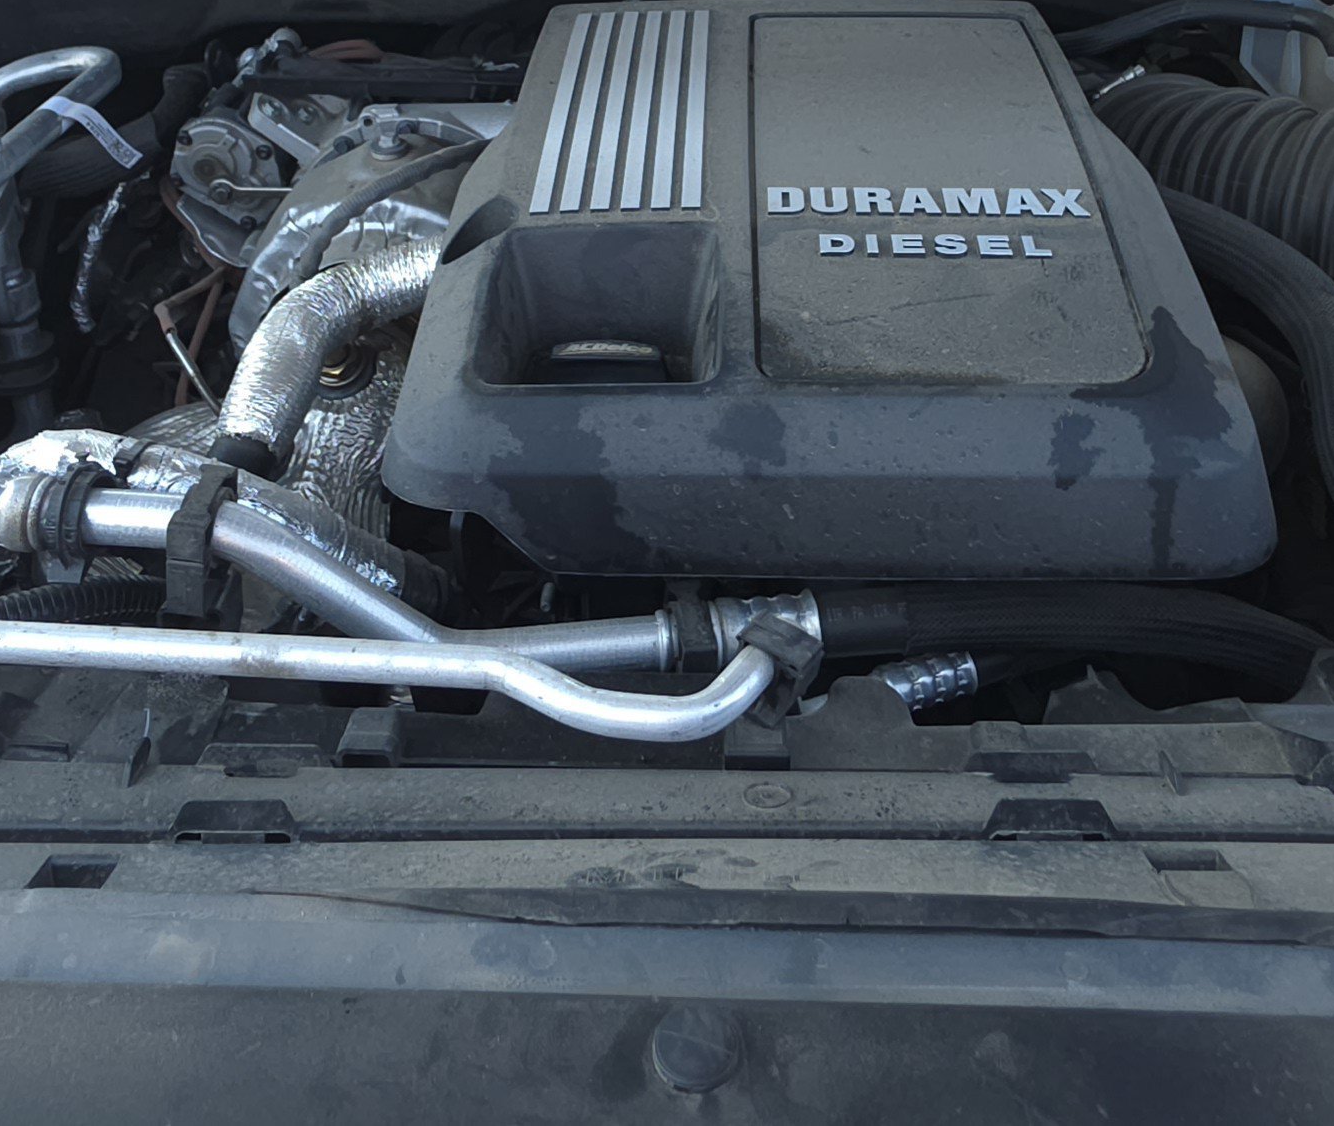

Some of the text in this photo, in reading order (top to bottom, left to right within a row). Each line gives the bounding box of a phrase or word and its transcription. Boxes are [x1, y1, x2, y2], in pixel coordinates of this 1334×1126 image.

[767, 187, 1091, 217] DURAMAX
[819, 234, 1053, 257] DIESEL
[564, 342, 653, 354] ACDelco
